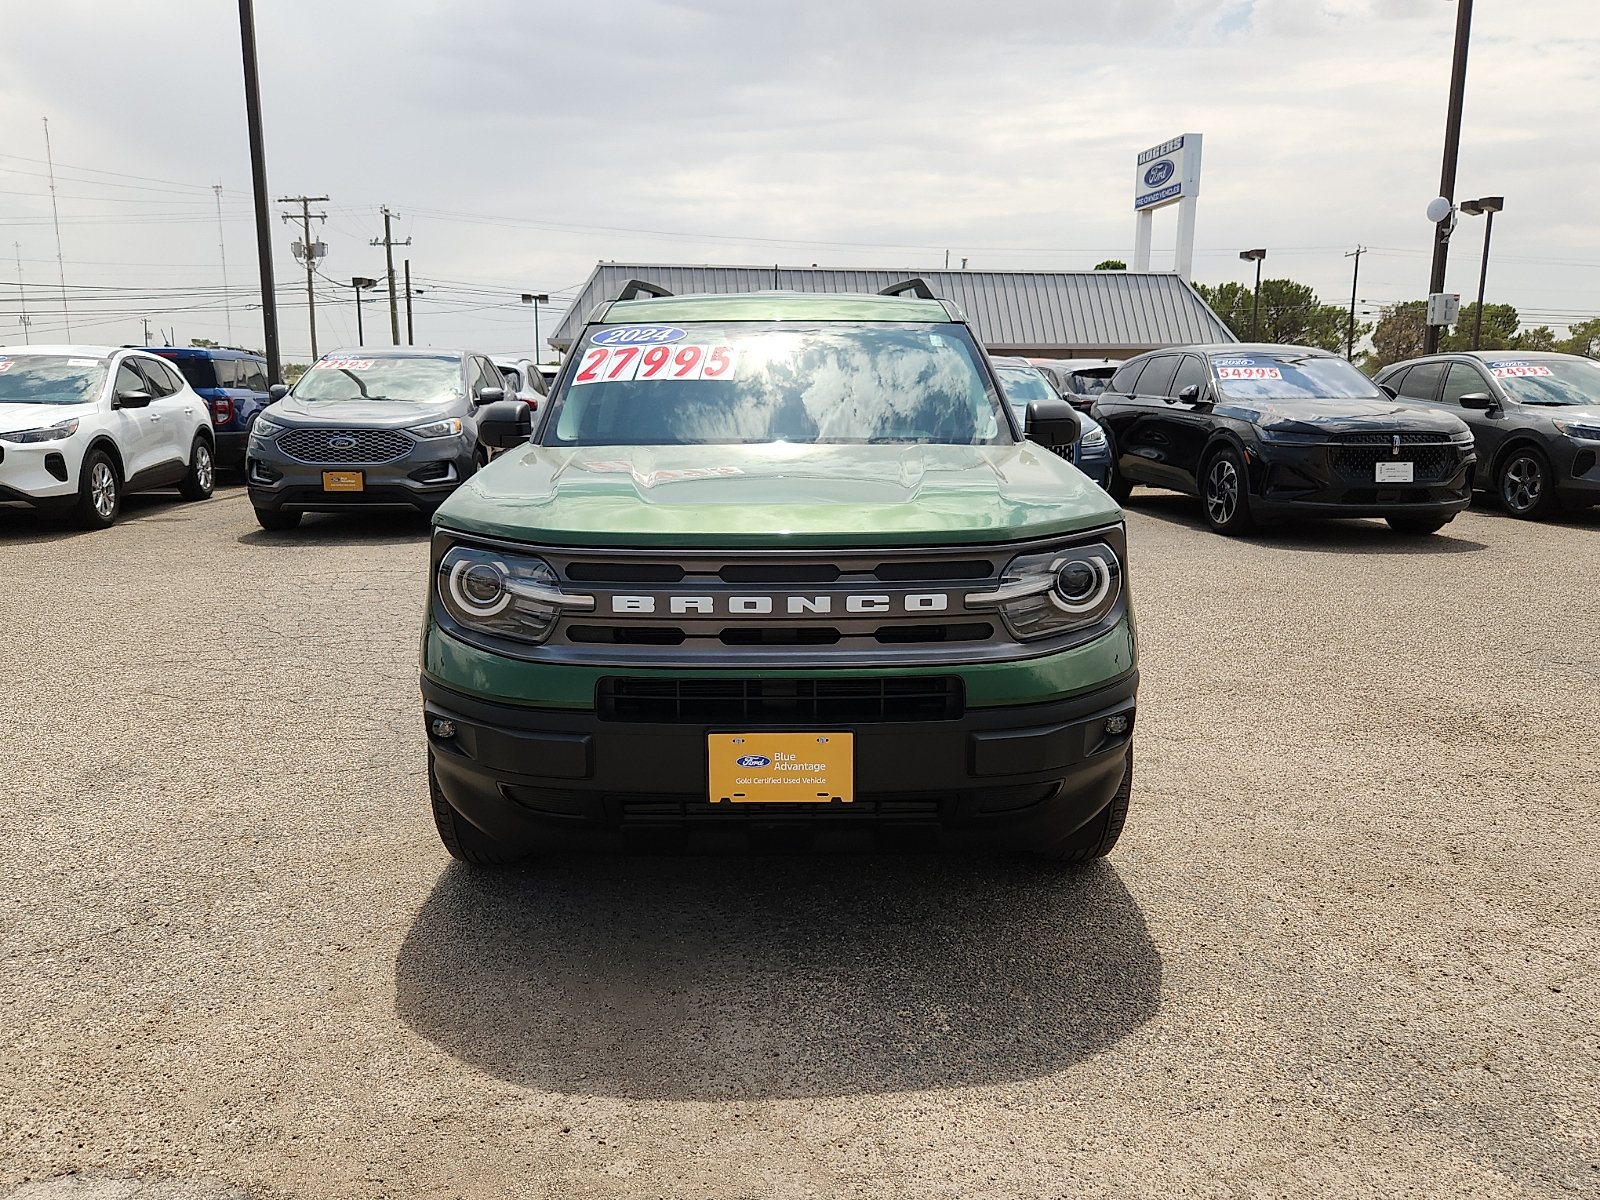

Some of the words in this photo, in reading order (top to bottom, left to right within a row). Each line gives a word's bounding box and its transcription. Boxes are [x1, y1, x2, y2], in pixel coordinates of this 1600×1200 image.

[1139, 136, 1183, 164] ROGERS
[1148, 164, 1168, 184] Ford
[602, 328, 674, 344] 2024
[576, 346, 733, 383] 27995
[1219, 368, 1279, 379] 54995
[1493, 366, 1550, 378] 24995
[612, 593, 948, 614] BRONCO
[742, 756, 766, 767] Ford
[774, 752, 796, 761] Blue
[774, 762, 826, 773] Advantage
[753, 777, 782, 785] Certified
